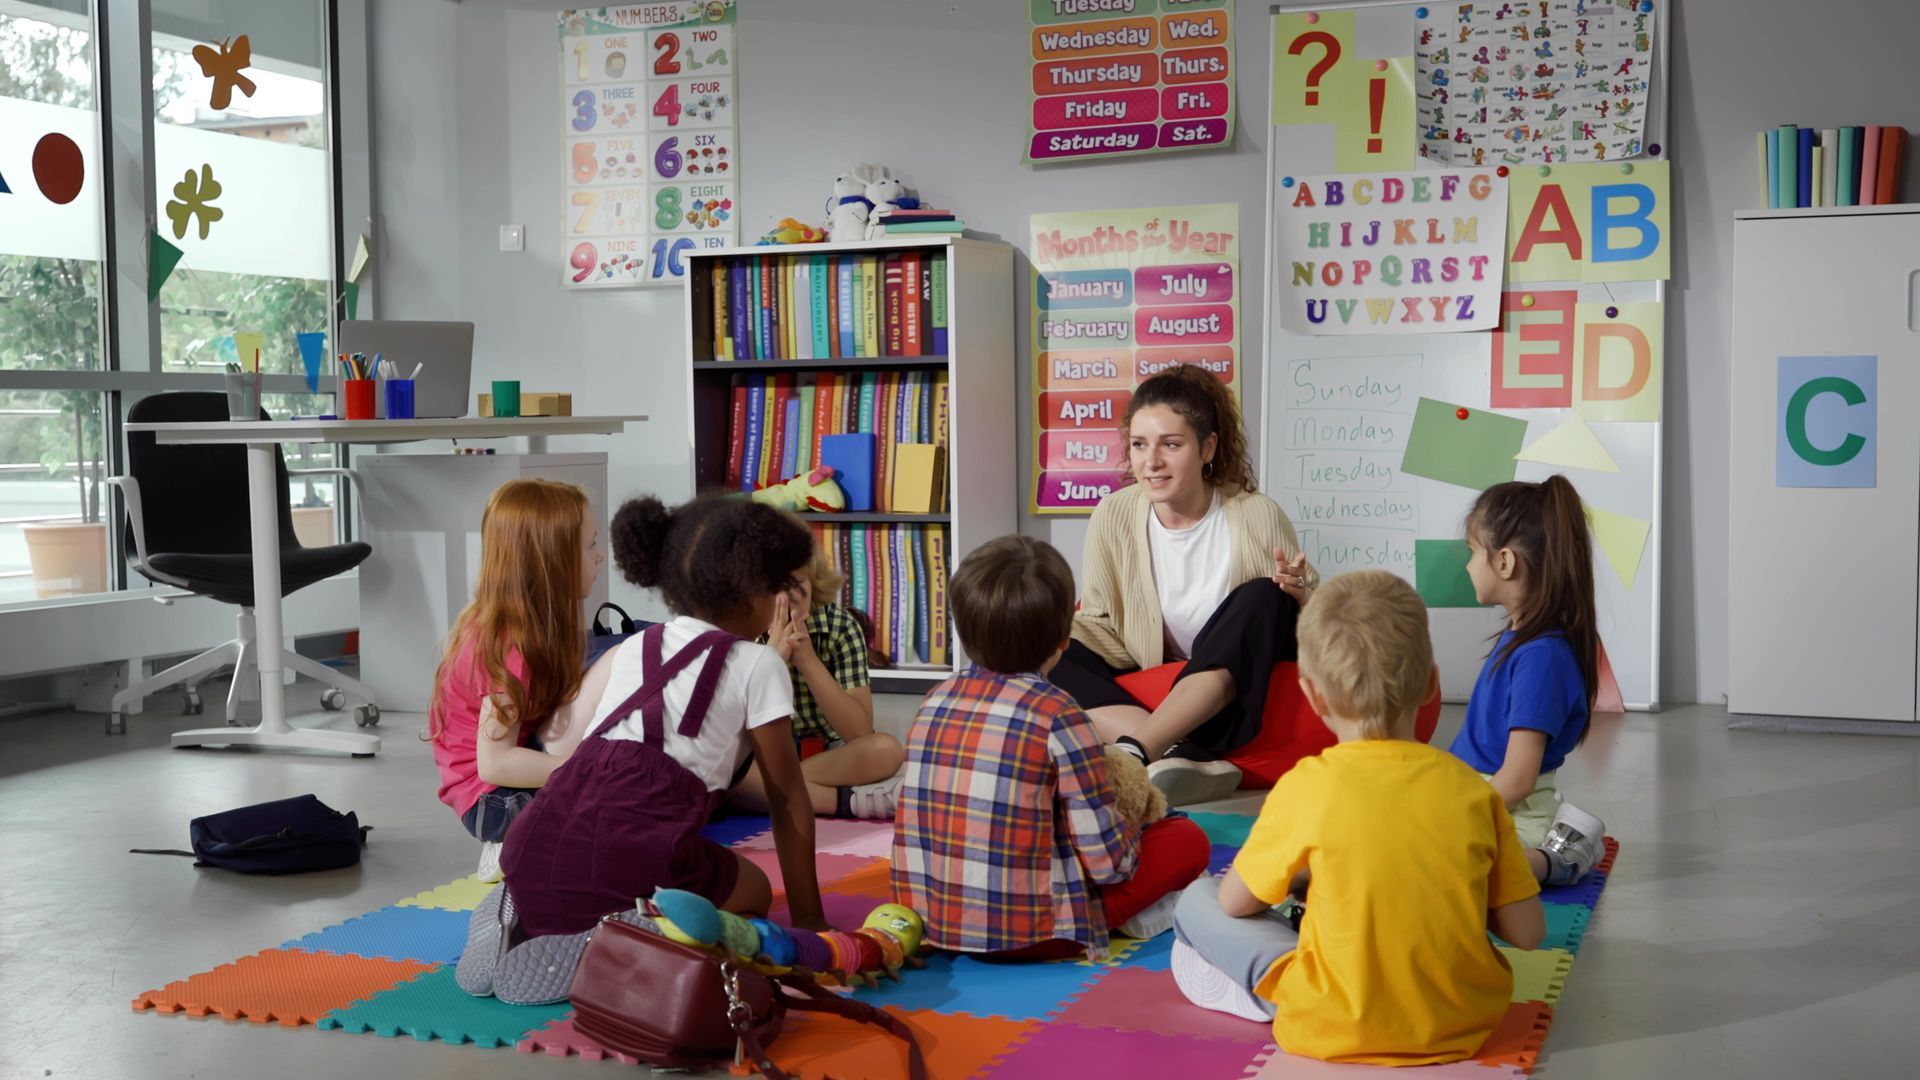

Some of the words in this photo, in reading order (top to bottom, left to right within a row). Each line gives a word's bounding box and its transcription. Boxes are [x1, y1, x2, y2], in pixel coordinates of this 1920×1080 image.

[615, 5, 679, 26] NUMBERS
[1168, 18, 1219, 39] Wed.
[604, 37, 628, 49] ONE
[692, 31, 717, 43] TWO
[1040, 26, 1151, 51] Wednesday
[654, 32, 681, 75] 2
[1163, 57, 1225, 75] Thurs.
[690, 82, 720, 94] FOUR
[1049, 63, 1141, 85] Thursday
[602, 87, 635, 100] THREE
[653, 84, 681, 127] 4
[1177, 92, 1211, 109] Fri.
[572, 89, 597, 132] 3
[1064, 100, 1127, 119] Friday
[607, 138, 635, 151] FIVE
[695, 135, 715, 146] SIX
[1049, 133, 1140, 152] Saturday
[1172, 124, 1212, 141] Sat.
[572, 141, 598, 184] 5
[655, 136, 682, 178] 6
[690, 185, 725, 198] EIGHT
[1292, 182, 1316, 207] A
[1324, 181, 1344, 206] B
[1352, 178, 1373, 205] C
[1381, 178, 1404, 203] D
[1411, 176, 1431, 203] E
[1440, 175, 1460, 201] F
[1469, 174, 1492, 201] G
[572, 191, 597, 234] 7
[655, 186, 682, 230] 8
[1511, 184, 1582, 262] A
[1036, 226, 1138, 259] Months
[1146, 218, 1159, 231] of
[1168, 220, 1233, 255] Year
[1308, 222, 1330, 248] H
[1340, 222, 1352, 247] I
[1362, 221, 1381, 246] J
[1393, 219, 1417, 245] K
[1426, 218, 1445, 244] L
[1452, 217, 1478, 243] M
[1591, 184, 1660, 263] B
[607, 241, 636, 253] NINE
[703, 236, 725, 248] TEN
[570, 242, 598, 283] 9
[651, 238, 697, 279] 10
[1292, 261, 1315, 287] N
[1322, 261, 1343, 287] O
[1352, 260, 1372, 285] P
[1380, 255, 1403, 287] Q
[1411, 258, 1433, 284] R
[1440, 257, 1459, 282] S
[1468, 255, 1488, 281] T
[907, 261, 916, 295] WORLD
[1046, 279, 1124, 299] January
[1160, 274, 1208, 297] July
[841, 271, 850, 328] MEDICINE
[891, 290, 899, 325] Book
[1305, 299, 1328, 324] U
[1335, 299, 1358, 325] V
[1365, 298, 1395, 325] W
[1400, 297, 1424, 323] X
[1429, 297, 1451, 322] Y
[1456, 295, 1474, 320] Z
[815, 295, 824, 343] SURGERY
[908, 302, 916, 344] HISTORY
[1044, 318, 1128, 339] February
[1148, 314, 1220, 337] August
[892, 328, 900, 351] Big
[1053, 359, 1117, 380] March
[1581, 322, 1651, 401] D
[1294, 360, 1401, 407] Sunday
[751, 387, 759, 421] Theory
[1060, 399, 1112, 428] April
[751, 423, 757, 434] of
[1293, 416, 1394, 448] Monday
[1786, 376, 1867, 466] C
[745, 435, 757, 484] Relativity
[1065, 440, 1108, 463] May
[1296, 453, 1393, 490] Tuesday
[1058, 481, 1111, 502] June
[1296, 495, 1413, 521] Wednesday
[1296, 529, 1416, 568] Thursday
[933, 538, 943, 649] PHYSICS
